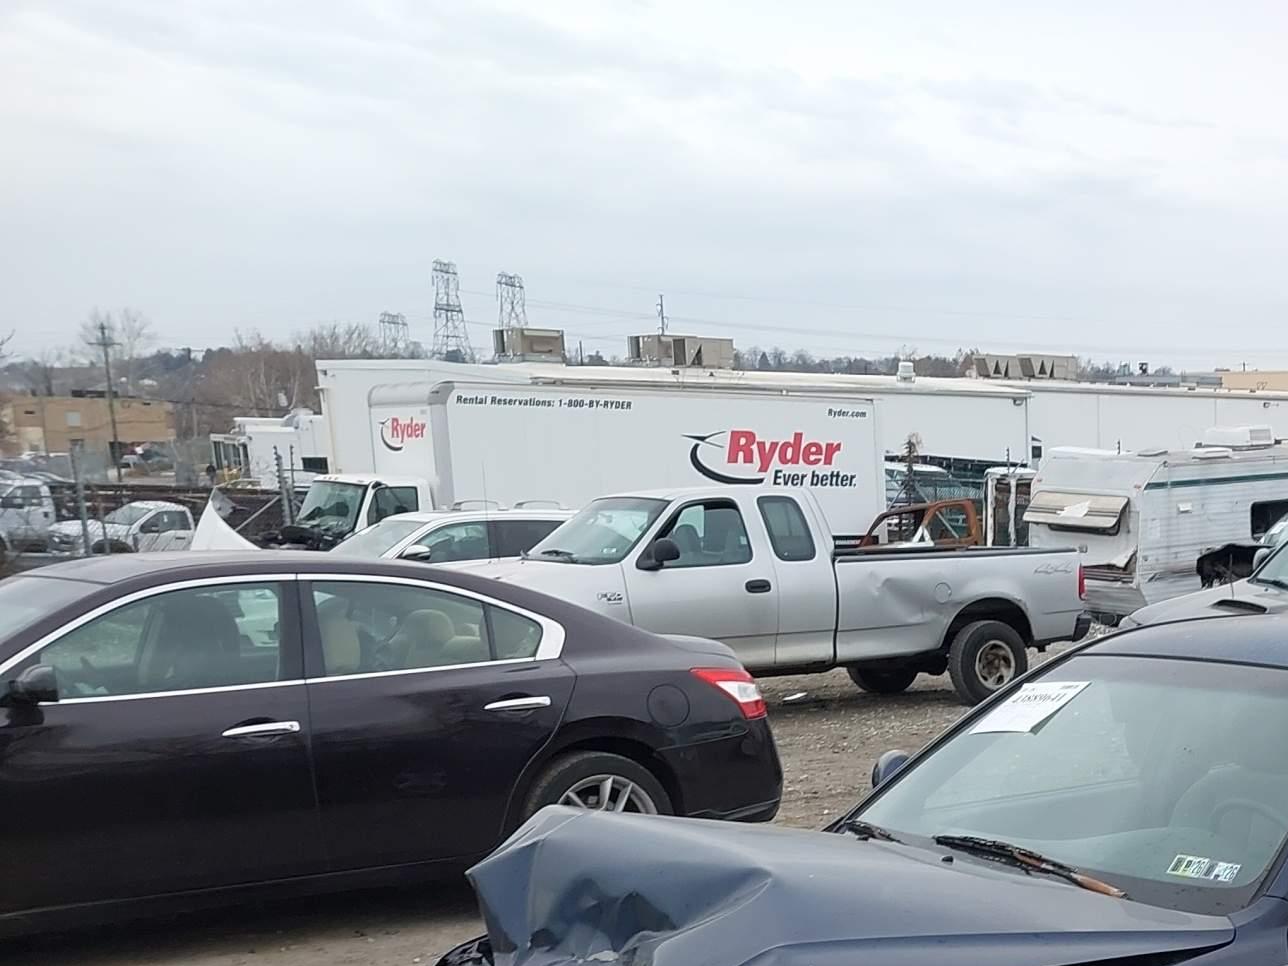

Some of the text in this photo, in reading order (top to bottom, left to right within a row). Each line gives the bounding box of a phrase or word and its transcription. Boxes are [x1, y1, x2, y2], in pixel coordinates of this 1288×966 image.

[456, 395, 632, 410] Rental Reservations: 1-800-BY-RYDER
[827, 408, 867, 418] Ryder.com
[391, 416, 426, 443] Ryder
[727, 430, 842, 473] Ryder
[773, 469, 857, 487] Ever better.
